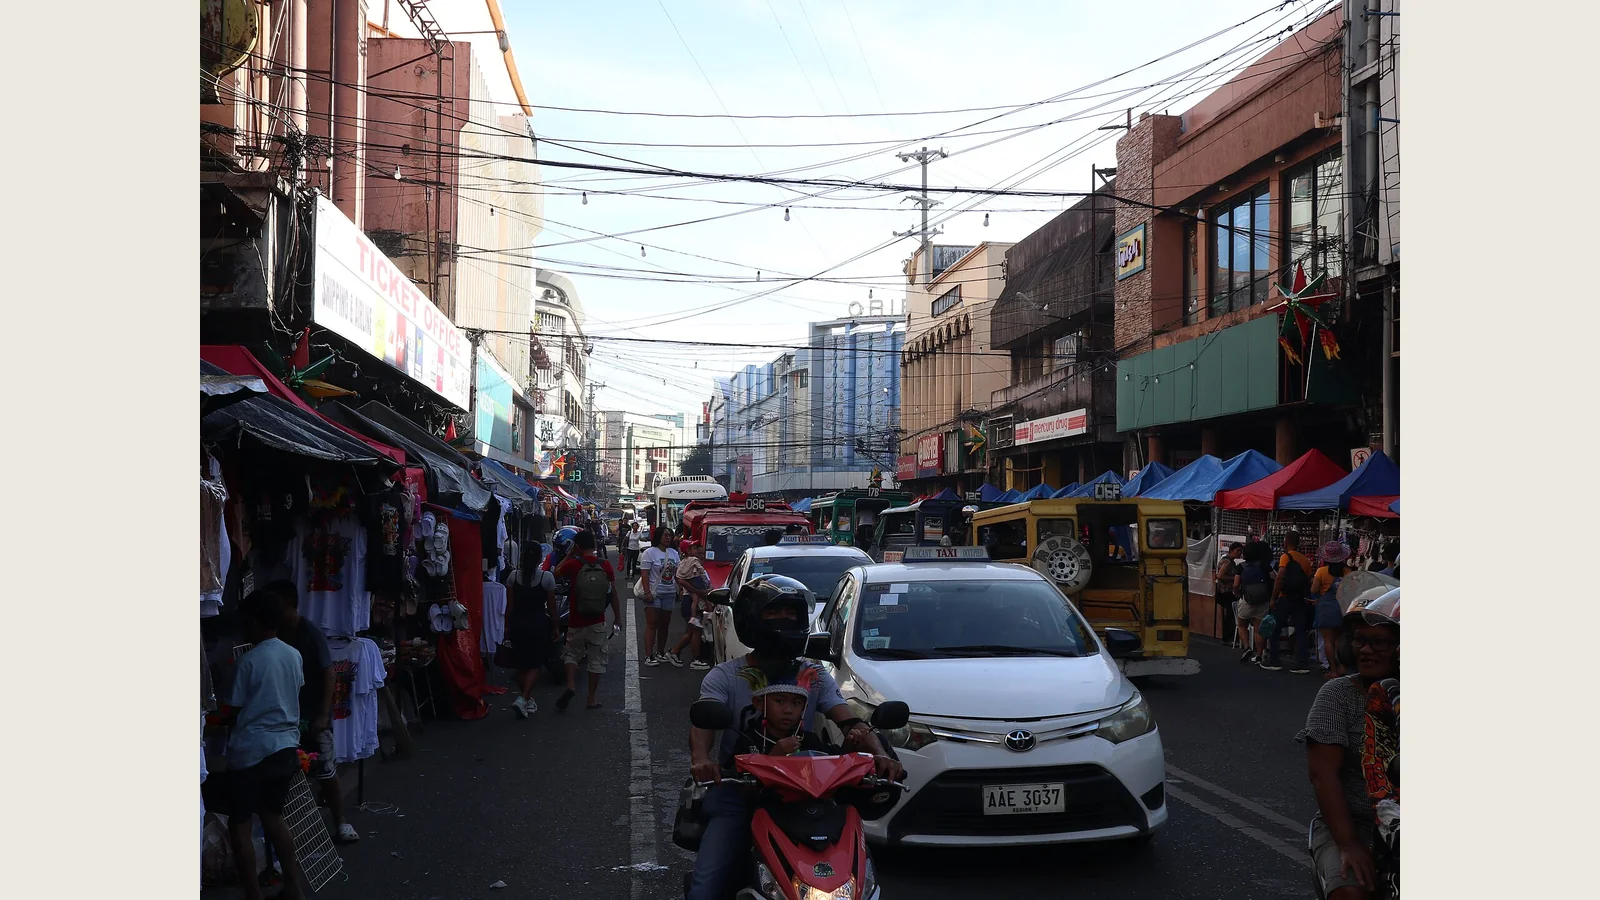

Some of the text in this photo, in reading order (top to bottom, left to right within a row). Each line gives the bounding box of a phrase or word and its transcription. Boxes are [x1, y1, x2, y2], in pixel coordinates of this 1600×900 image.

[356, 236, 461, 357] TICKET OFFICE
[1034, 417, 1068, 434] mercury drug
[868, 487, 880, 497] 17B
[964, 492, 981, 501] 12C
[746, 498, 765, 510] 08G
[912, 549, 932, 558] VACANT
[936, 548, 957, 558] TAXI
[962, 549, 984, 558] OCCUPIED
[988, 788, 1060, 808] AAE 3037
